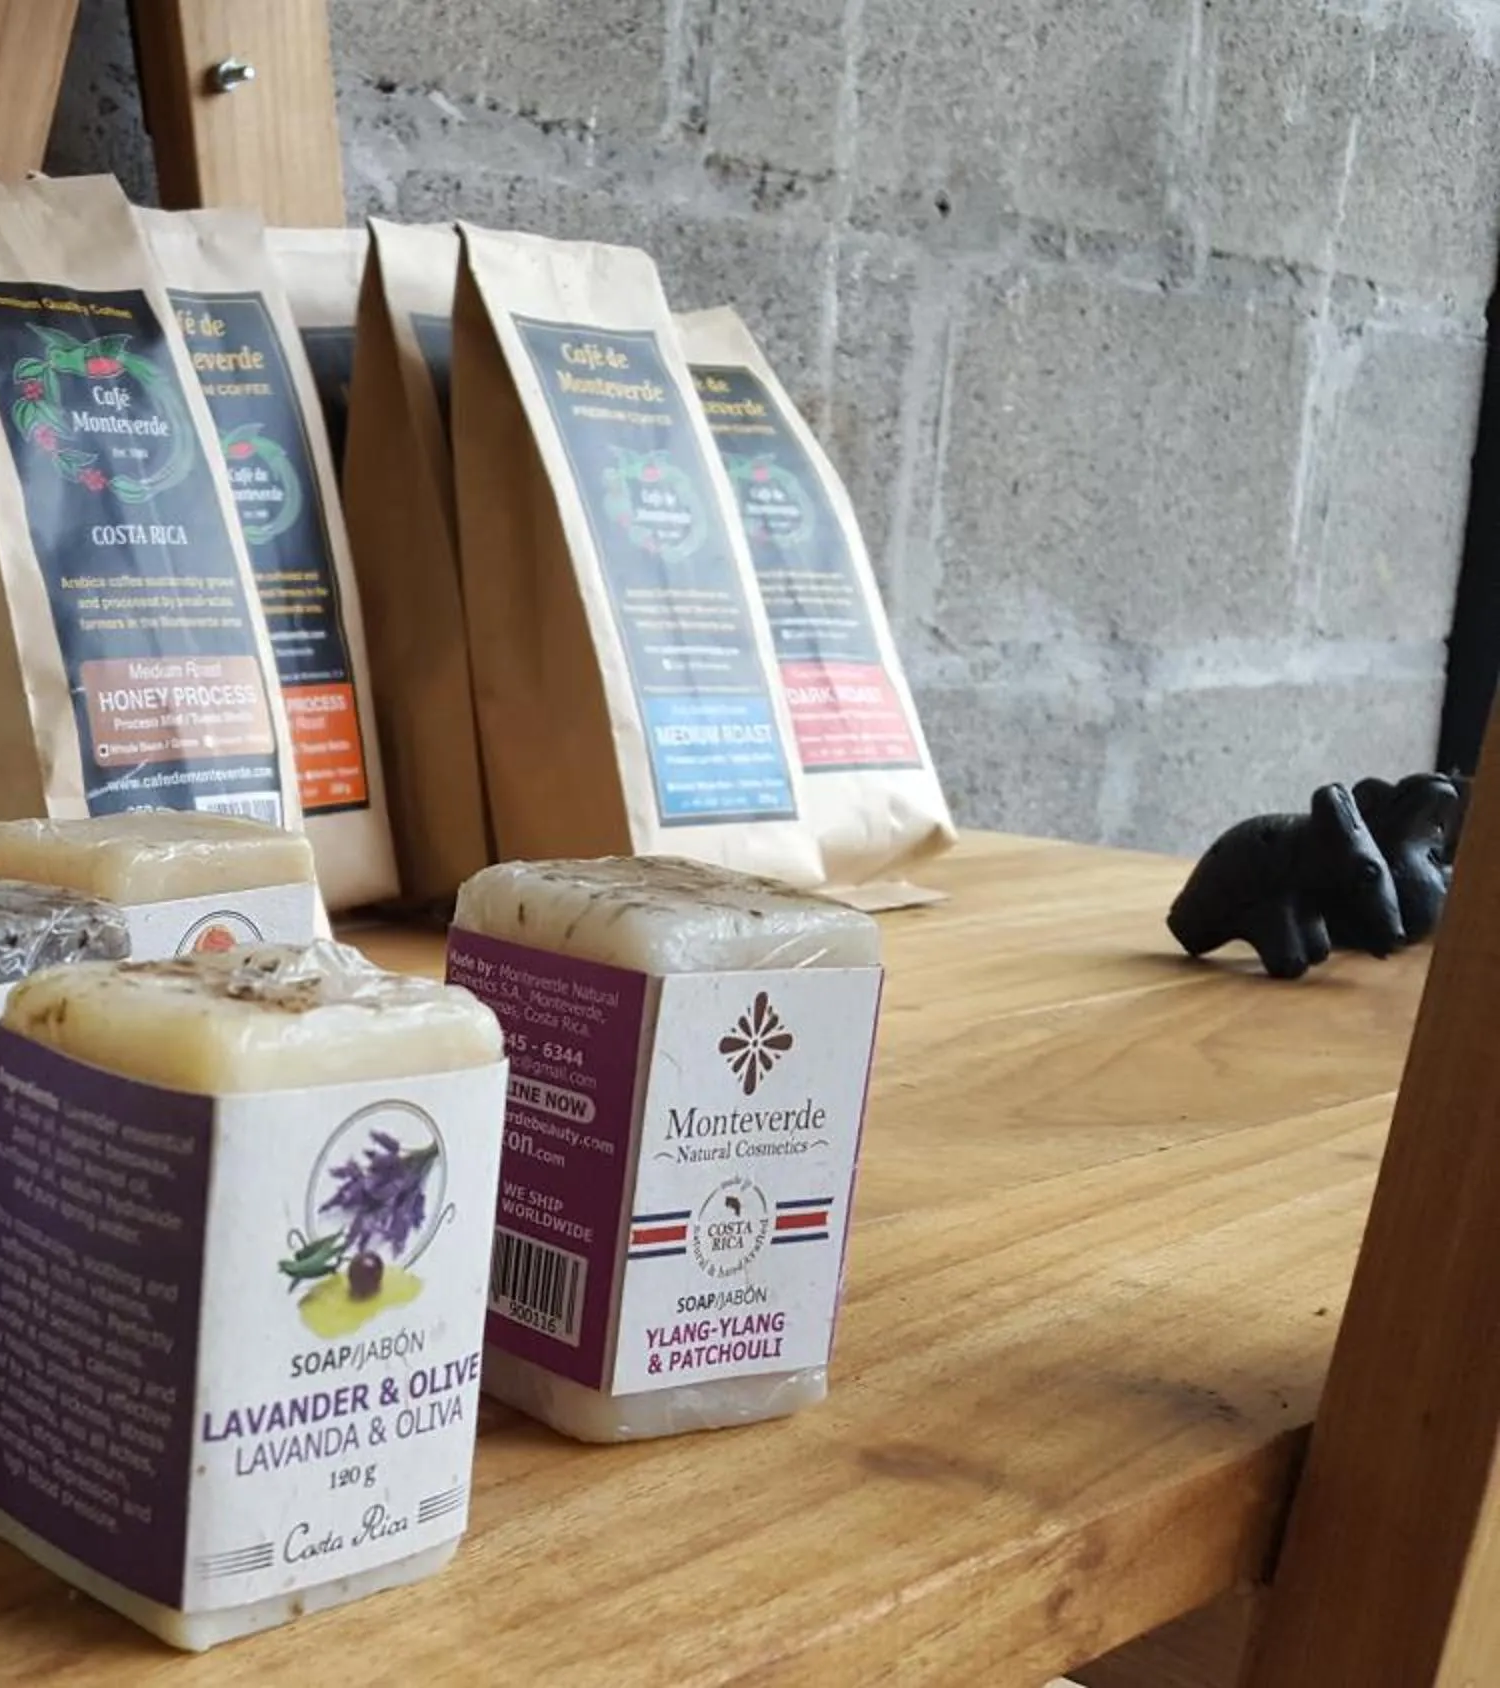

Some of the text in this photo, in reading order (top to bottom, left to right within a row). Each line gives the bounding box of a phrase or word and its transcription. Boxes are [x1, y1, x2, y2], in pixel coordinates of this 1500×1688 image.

[200, 312, 226, 338] de
[193, 345, 265, 371] everde
[561, 342, 605, 370] Café
[92, 384, 132, 411] Café
[556, 370, 666, 402] Monteverde
[72, 410, 171, 438] Monteverde
[91, 524, 189, 546] COSTA RICA
[129, 661, 184, 680] Medium
[97, 682, 257, 713] HONEY PROCESS
[499, 963, 570, 994] Monteverde
[572, 981, 620, 1008] Natural
[506, 1031, 528, 1052] 45
[543, 1041, 584, 1067] 6344
[507, 1081, 588, 1118] INE NOW
[664, 1098, 827, 1141] Monteverde
[503, 1130, 566, 1168] on.com
[675, 1137, 810, 1164] Natural Cosmetics
[503, 1180, 564, 1211] WE SHIP
[501, 1197, 595, 1243] WORLDWIDE
[707, 1220, 753, 1252] COSTA RICA
[145, 1278, 180, 1303] and
[676, 1284, 768, 1315] SOAP/JABÓN
[508, 1301, 558, 1334] 900116
[646, 1311, 786, 1349] YLANG-YLANG
[290, 1327, 426, 1379] SOAP/JABÓN
[647, 1337, 784, 1374] & PATCHOULI
[144, 1379, 177, 1404] and
[202, 1352, 480, 1443] LAVANDER & OLIVE
[235, 1395, 464, 1477] LAVANDA & OLIVA
[329, 1464, 378, 1489] 120 g
[282, 1504, 409, 1565] Costa Rica
